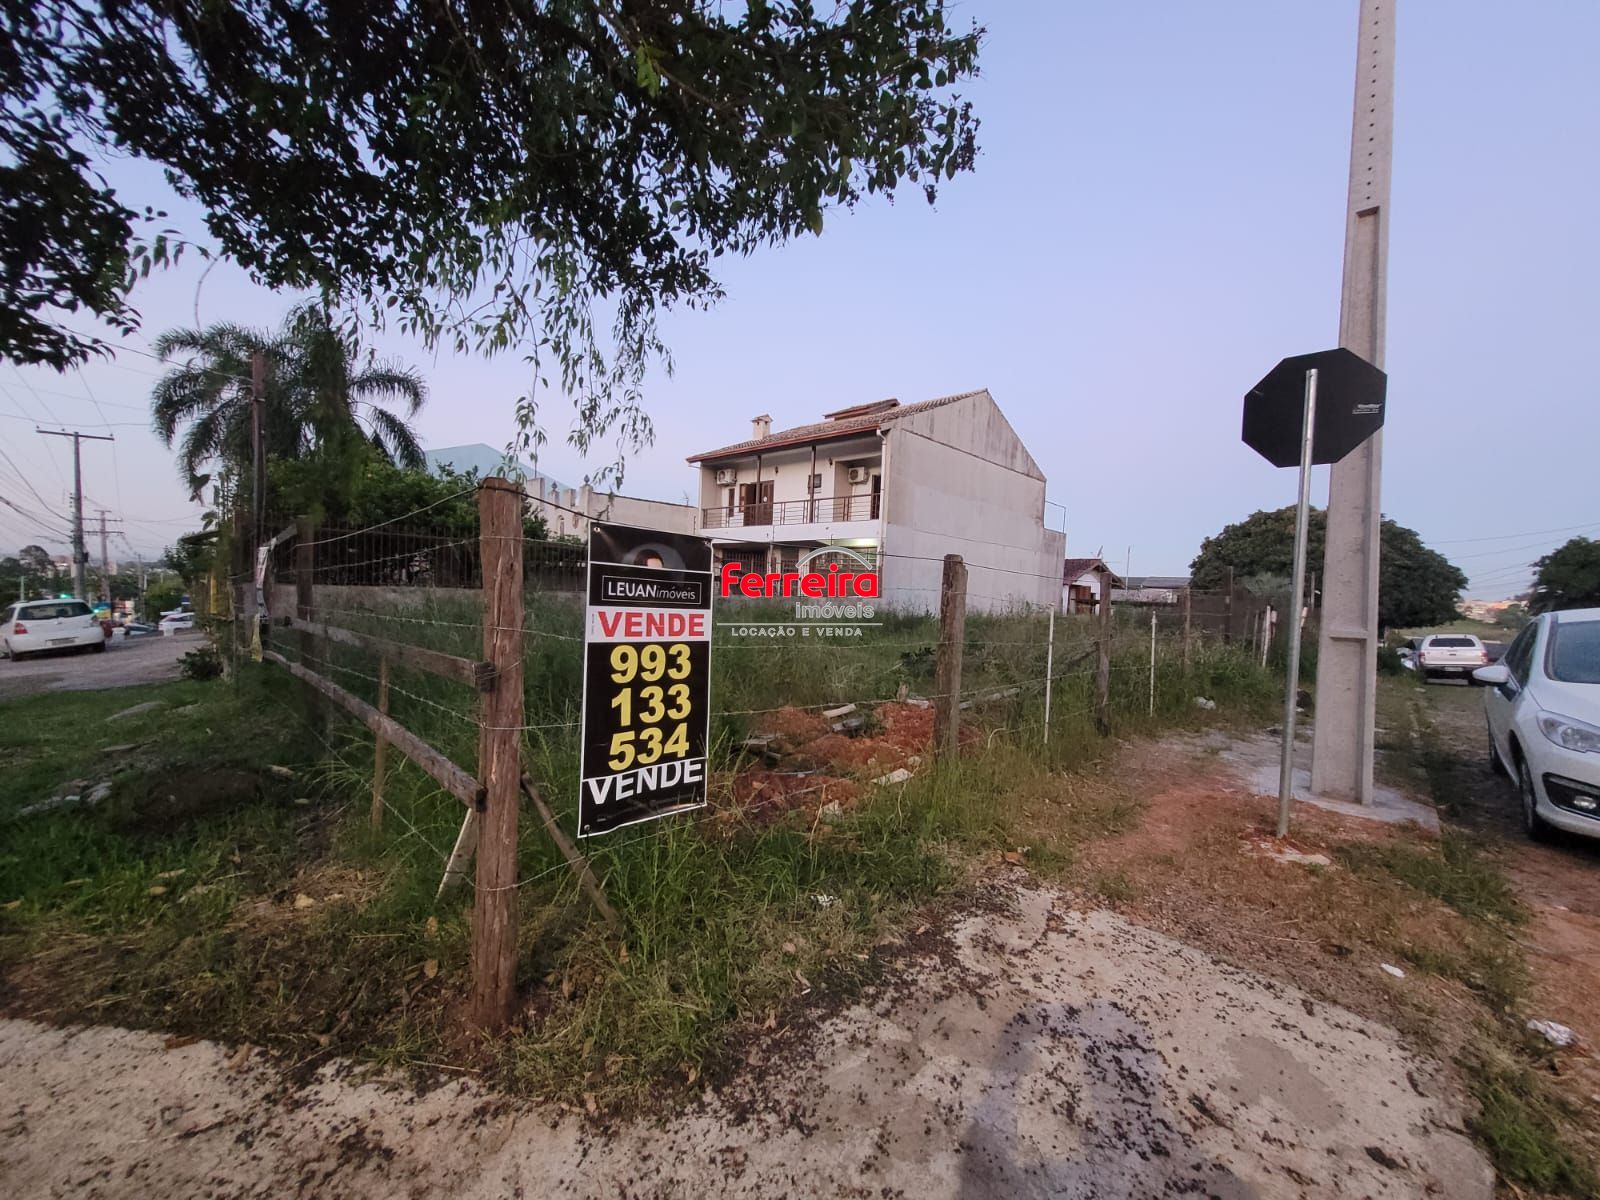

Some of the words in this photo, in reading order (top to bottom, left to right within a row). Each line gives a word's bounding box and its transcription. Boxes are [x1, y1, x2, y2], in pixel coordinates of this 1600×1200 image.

[598, 611, 705, 638] VENDE
[610, 643, 692, 684] 993
[611, 683, 692, 727] 133
[608, 722, 690, 771] 534
[587, 759, 703, 805] VENDE
